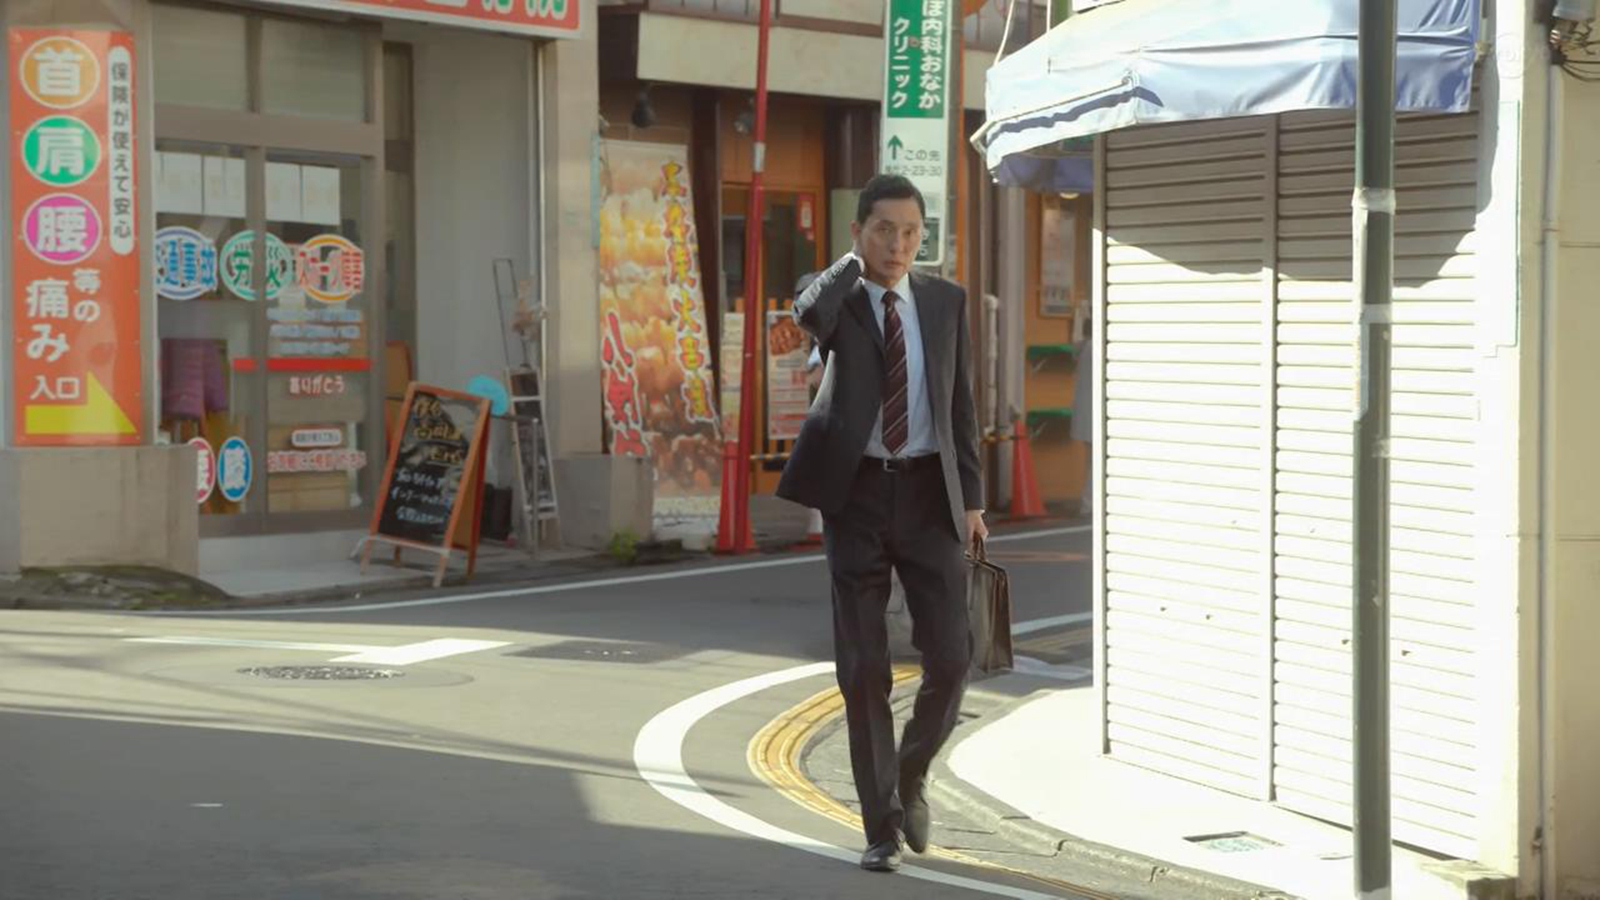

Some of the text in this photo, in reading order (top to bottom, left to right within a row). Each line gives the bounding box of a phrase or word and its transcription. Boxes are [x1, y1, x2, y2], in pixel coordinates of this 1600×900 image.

[33, 46, 85, 96] 首
[891, 16, 911, 108] クリニック
[36, 126, 86, 176] 肩
[36, 205, 88, 253] 腰
[25, 276, 70, 362] 痛み
[30, 374, 81, 400] 入口
